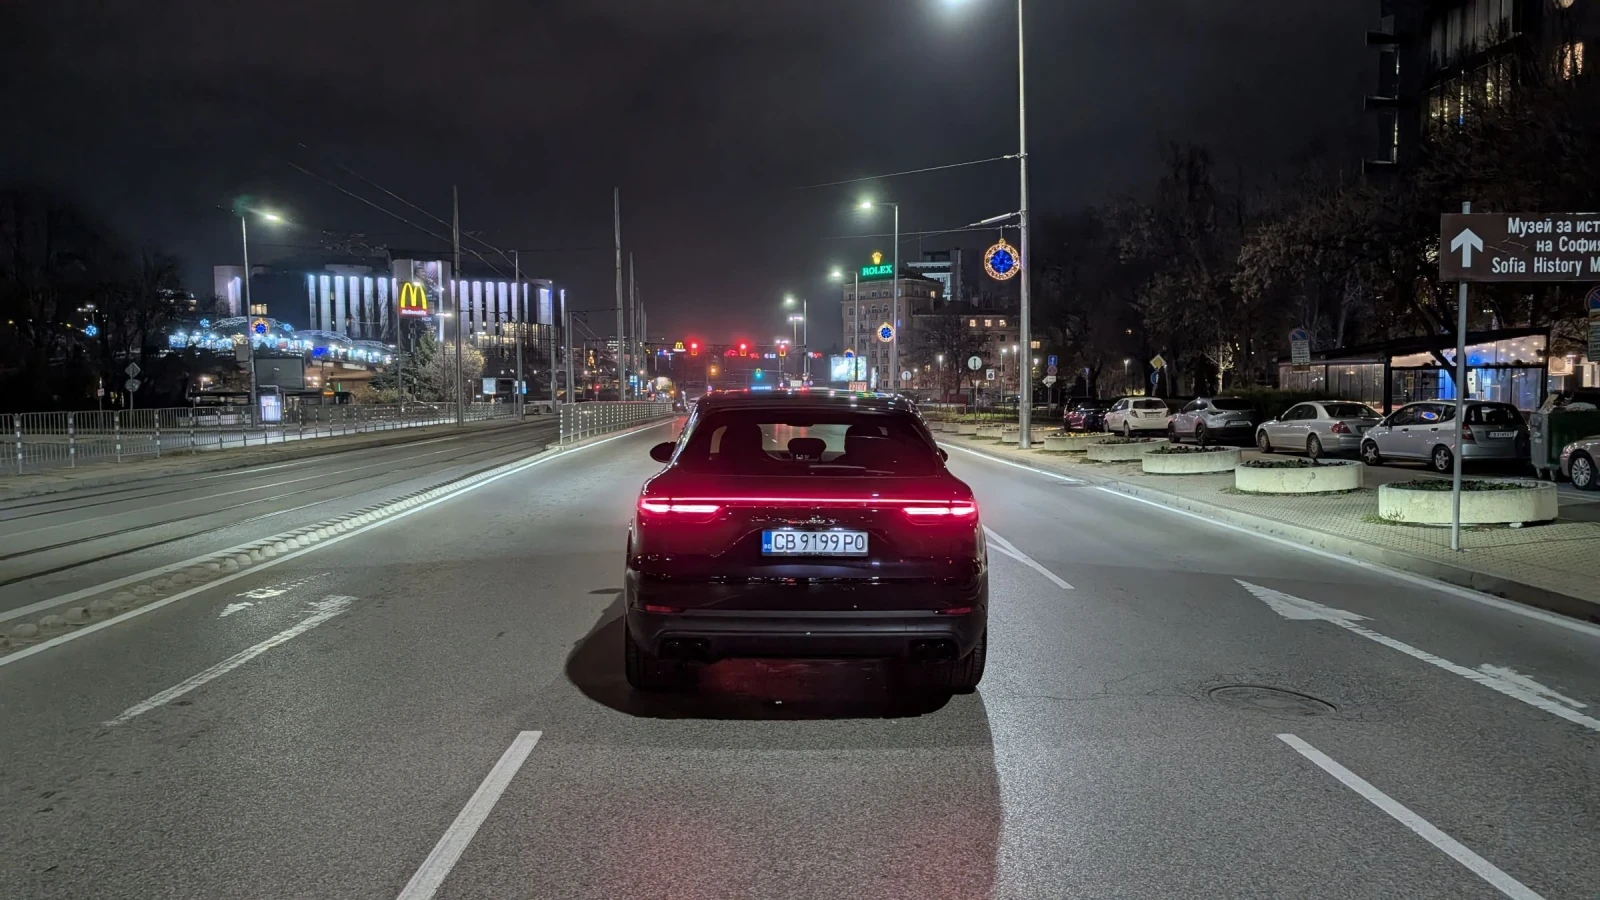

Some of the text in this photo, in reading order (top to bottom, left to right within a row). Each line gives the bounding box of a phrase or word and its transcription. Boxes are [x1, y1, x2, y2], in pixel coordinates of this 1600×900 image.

[1507, 217, 1552, 238] Музей
[1556, 220, 1571, 233] за
[1536, 240, 1552, 252] на
[862, 264, 893, 276] ROLEX
[1492, 257, 1526, 273] Sofia
[1534, 257, 1582, 277] History
[774, 533, 796, 550] CB
[800, 533, 839, 551] 9199
